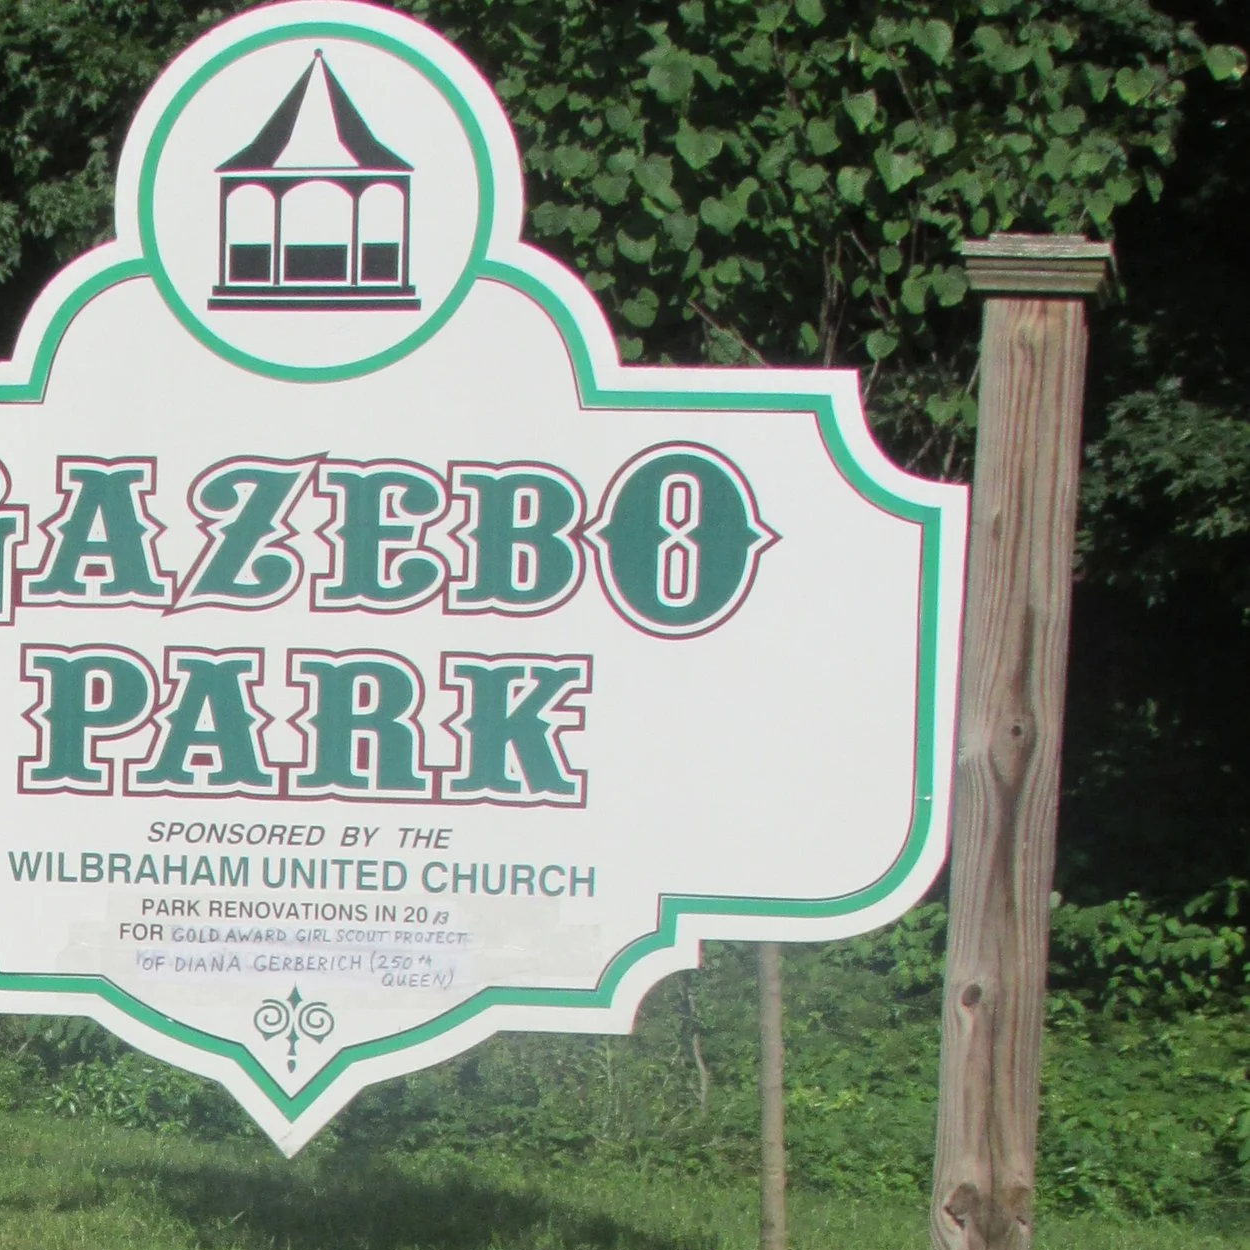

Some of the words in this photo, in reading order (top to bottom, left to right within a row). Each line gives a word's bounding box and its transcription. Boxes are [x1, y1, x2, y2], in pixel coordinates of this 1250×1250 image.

[17, 643, 593, 808] PARK
[147, 821, 325, 846] SPONSORED
[340, 826, 379, 847] BY
[398, 828, 453, 849] THE
[8, 851, 249, 887] WILBRAHAM
[262, 857, 408, 892] UNITED
[421, 861, 596, 897] CHURCH
[142, 899, 201, 918] PARK
[209, 900, 368, 922] RENOVATIONS
[375, 905, 396, 922] IN
[119, 923, 163, 941] FOR
[172, 927, 220, 943] GOLD
[225, 928, 287, 943] AWARD
[296, 929, 331, 944] GIRL
[336, 930, 390, 943] SCOUT
[395, 930, 469, 945] PROJECT
[142, 956, 166, 972] OF
[174, 954, 241, 972] DIANA
[253, 954, 362, 972] GERBERICH
[381, 969, 456, 991] QUEEN)
